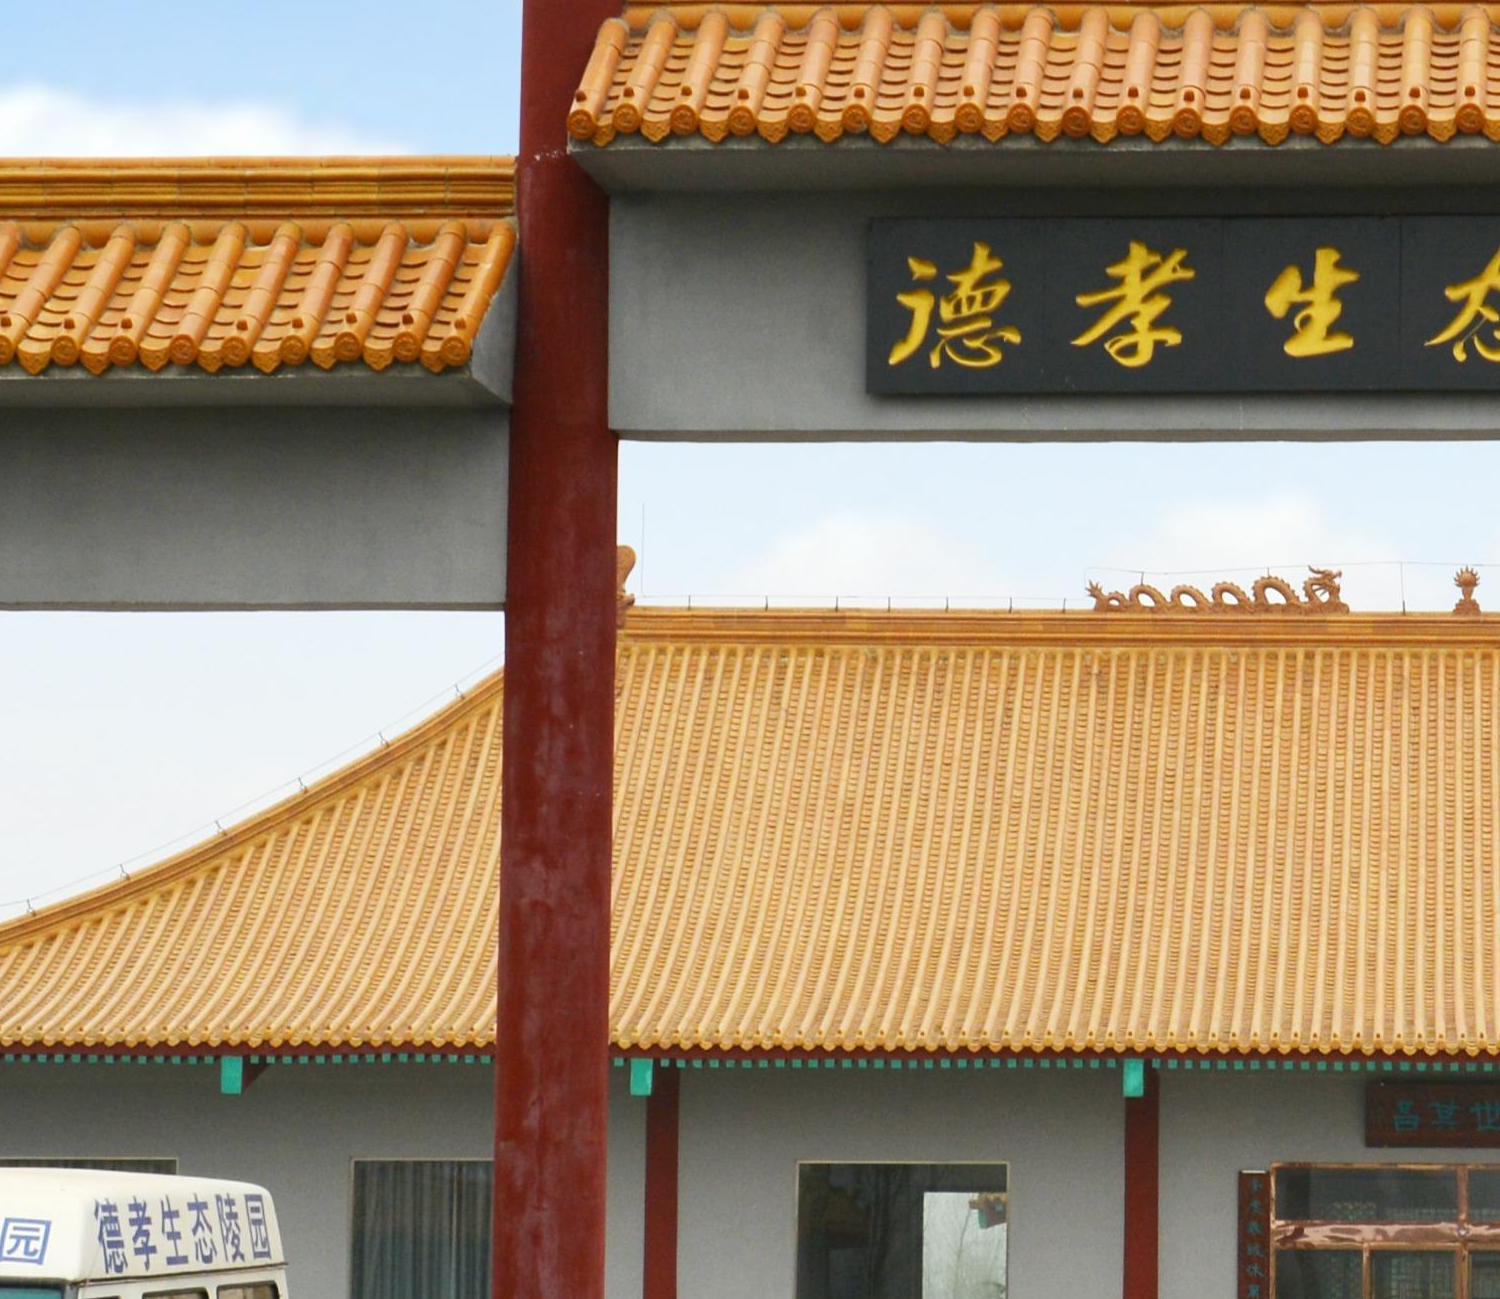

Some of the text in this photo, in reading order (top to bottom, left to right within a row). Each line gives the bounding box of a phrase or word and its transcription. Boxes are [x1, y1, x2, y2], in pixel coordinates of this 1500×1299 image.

[93, 1192, 272, 1275] 德孝生态陵园
